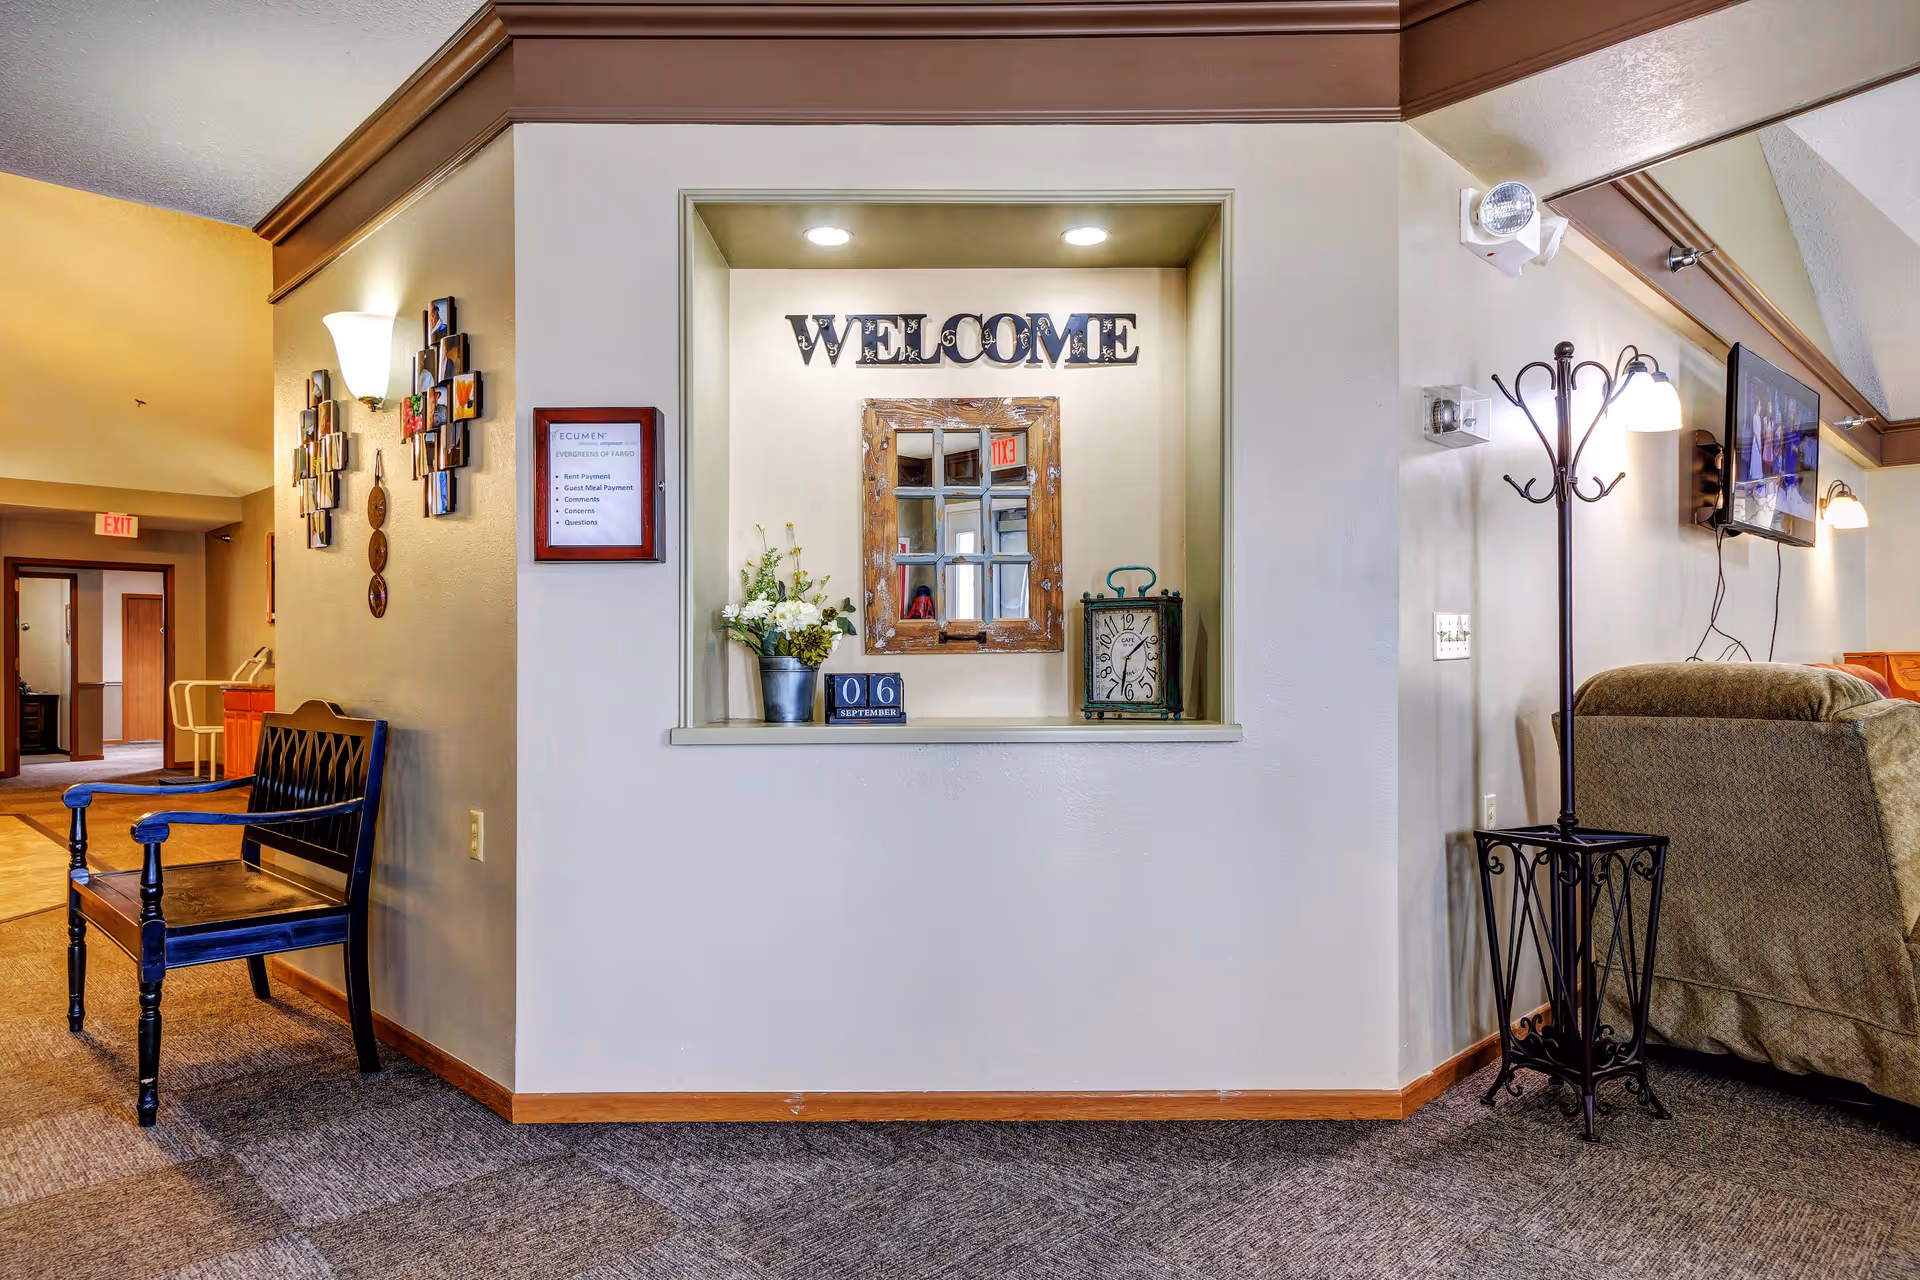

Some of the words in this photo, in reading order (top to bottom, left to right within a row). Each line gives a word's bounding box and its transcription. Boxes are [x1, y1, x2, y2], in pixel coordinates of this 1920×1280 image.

[785, 313, 1139, 367] WELCOME
[104, 515, 132, 536] EXIT
[1121, 613, 1135, 631] 12
[1139, 615, 1152, 635] 1
[1099, 633, 1112, 649] 10
[1145, 635, 1159, 649] 2
[1100, 652, 1111, 662] 9
[1147, 652, 1158, 661] 3
[1100, 666, 1112, 679] 8
[1146, 666, 1158, 682] 4
[1105, 678, 1119, 700] 7
[1124, 683, 1135, 701] 6
[1138, 676, 1154, 699] 5
[840, 708, 897, 717] SEPTEMBER
